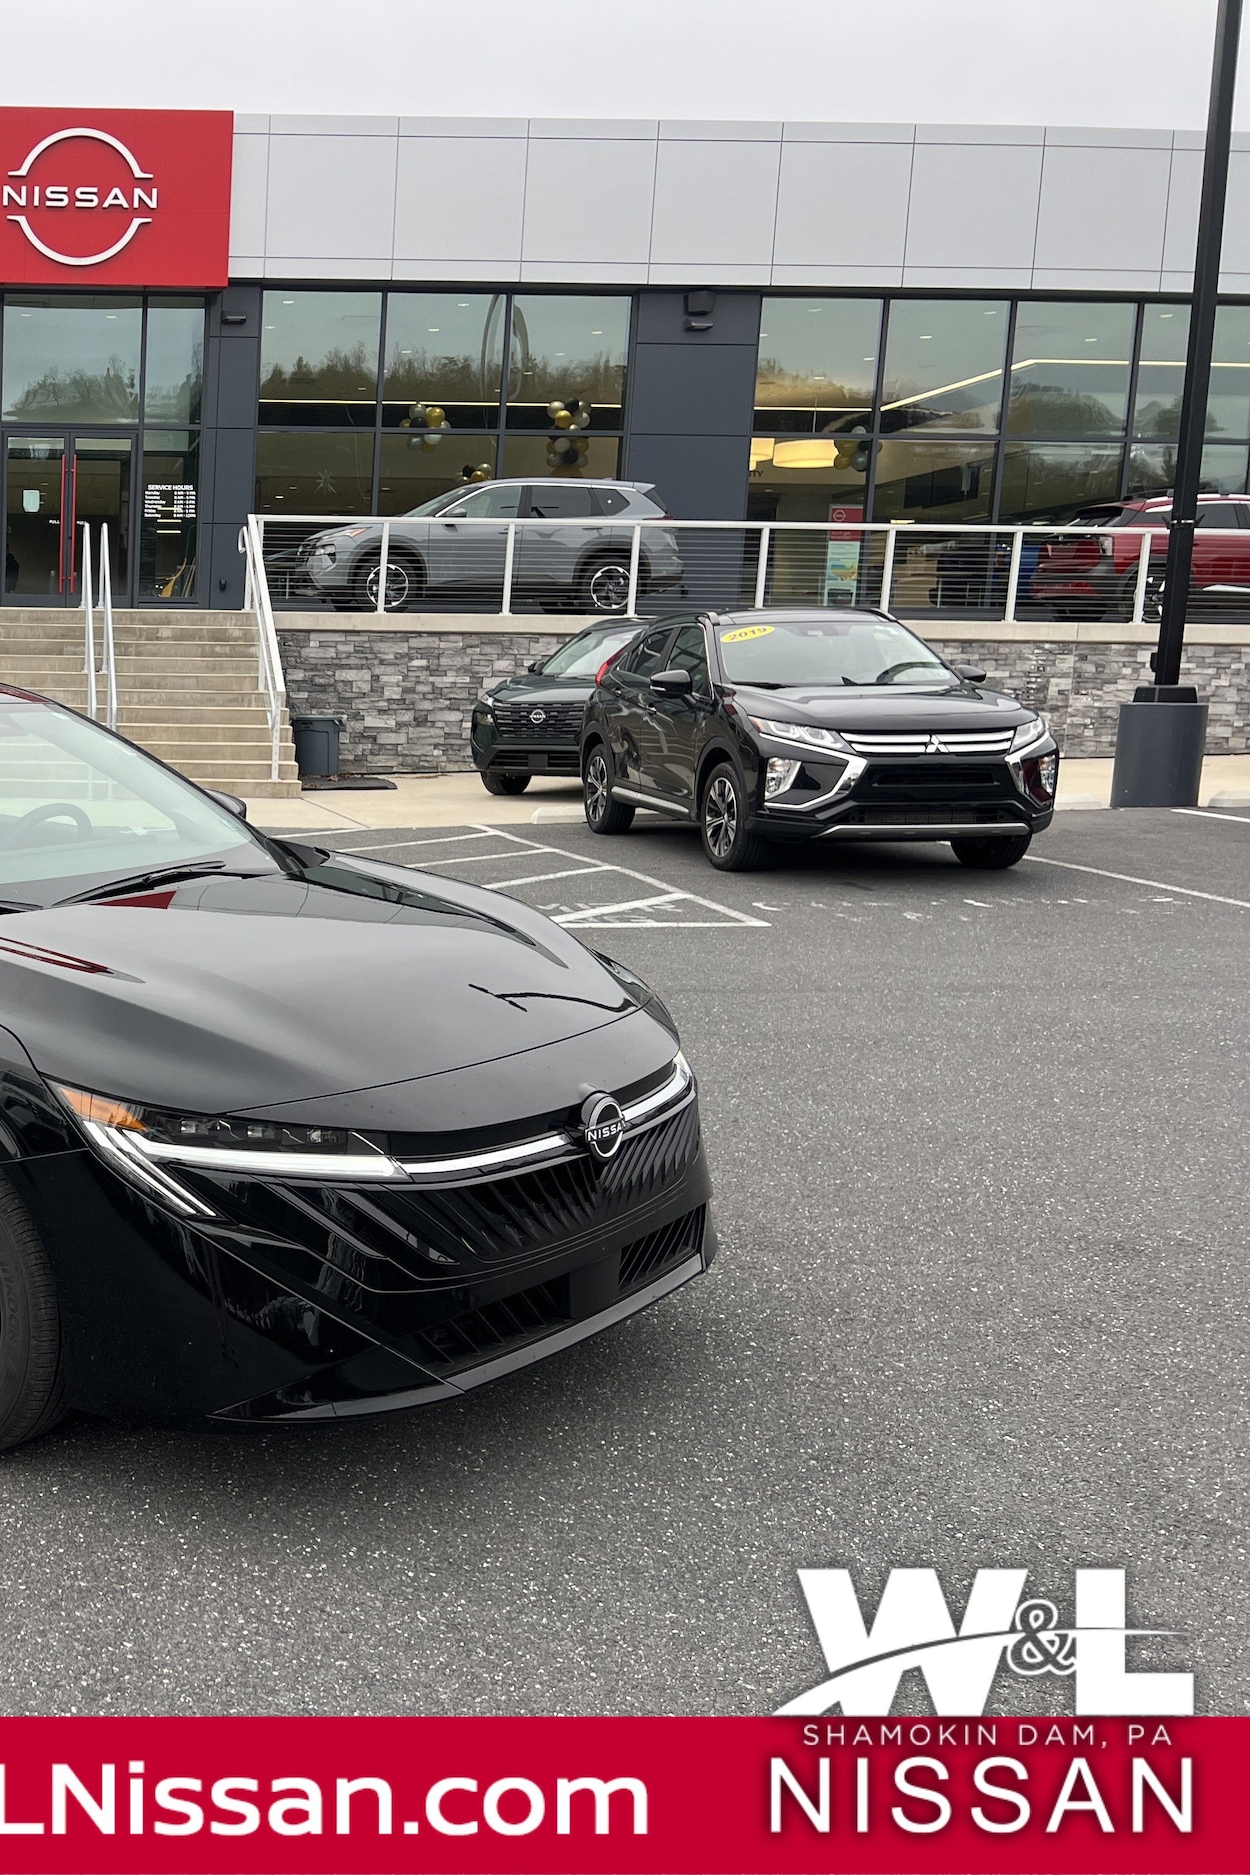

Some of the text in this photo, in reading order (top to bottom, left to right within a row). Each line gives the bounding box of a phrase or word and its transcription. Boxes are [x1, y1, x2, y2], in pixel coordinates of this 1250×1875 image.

[2, 185, 158, 209] NISSAN
[729, 627, 767, 641] 2019
[587, 1119, 627, 1142] NISSAN
